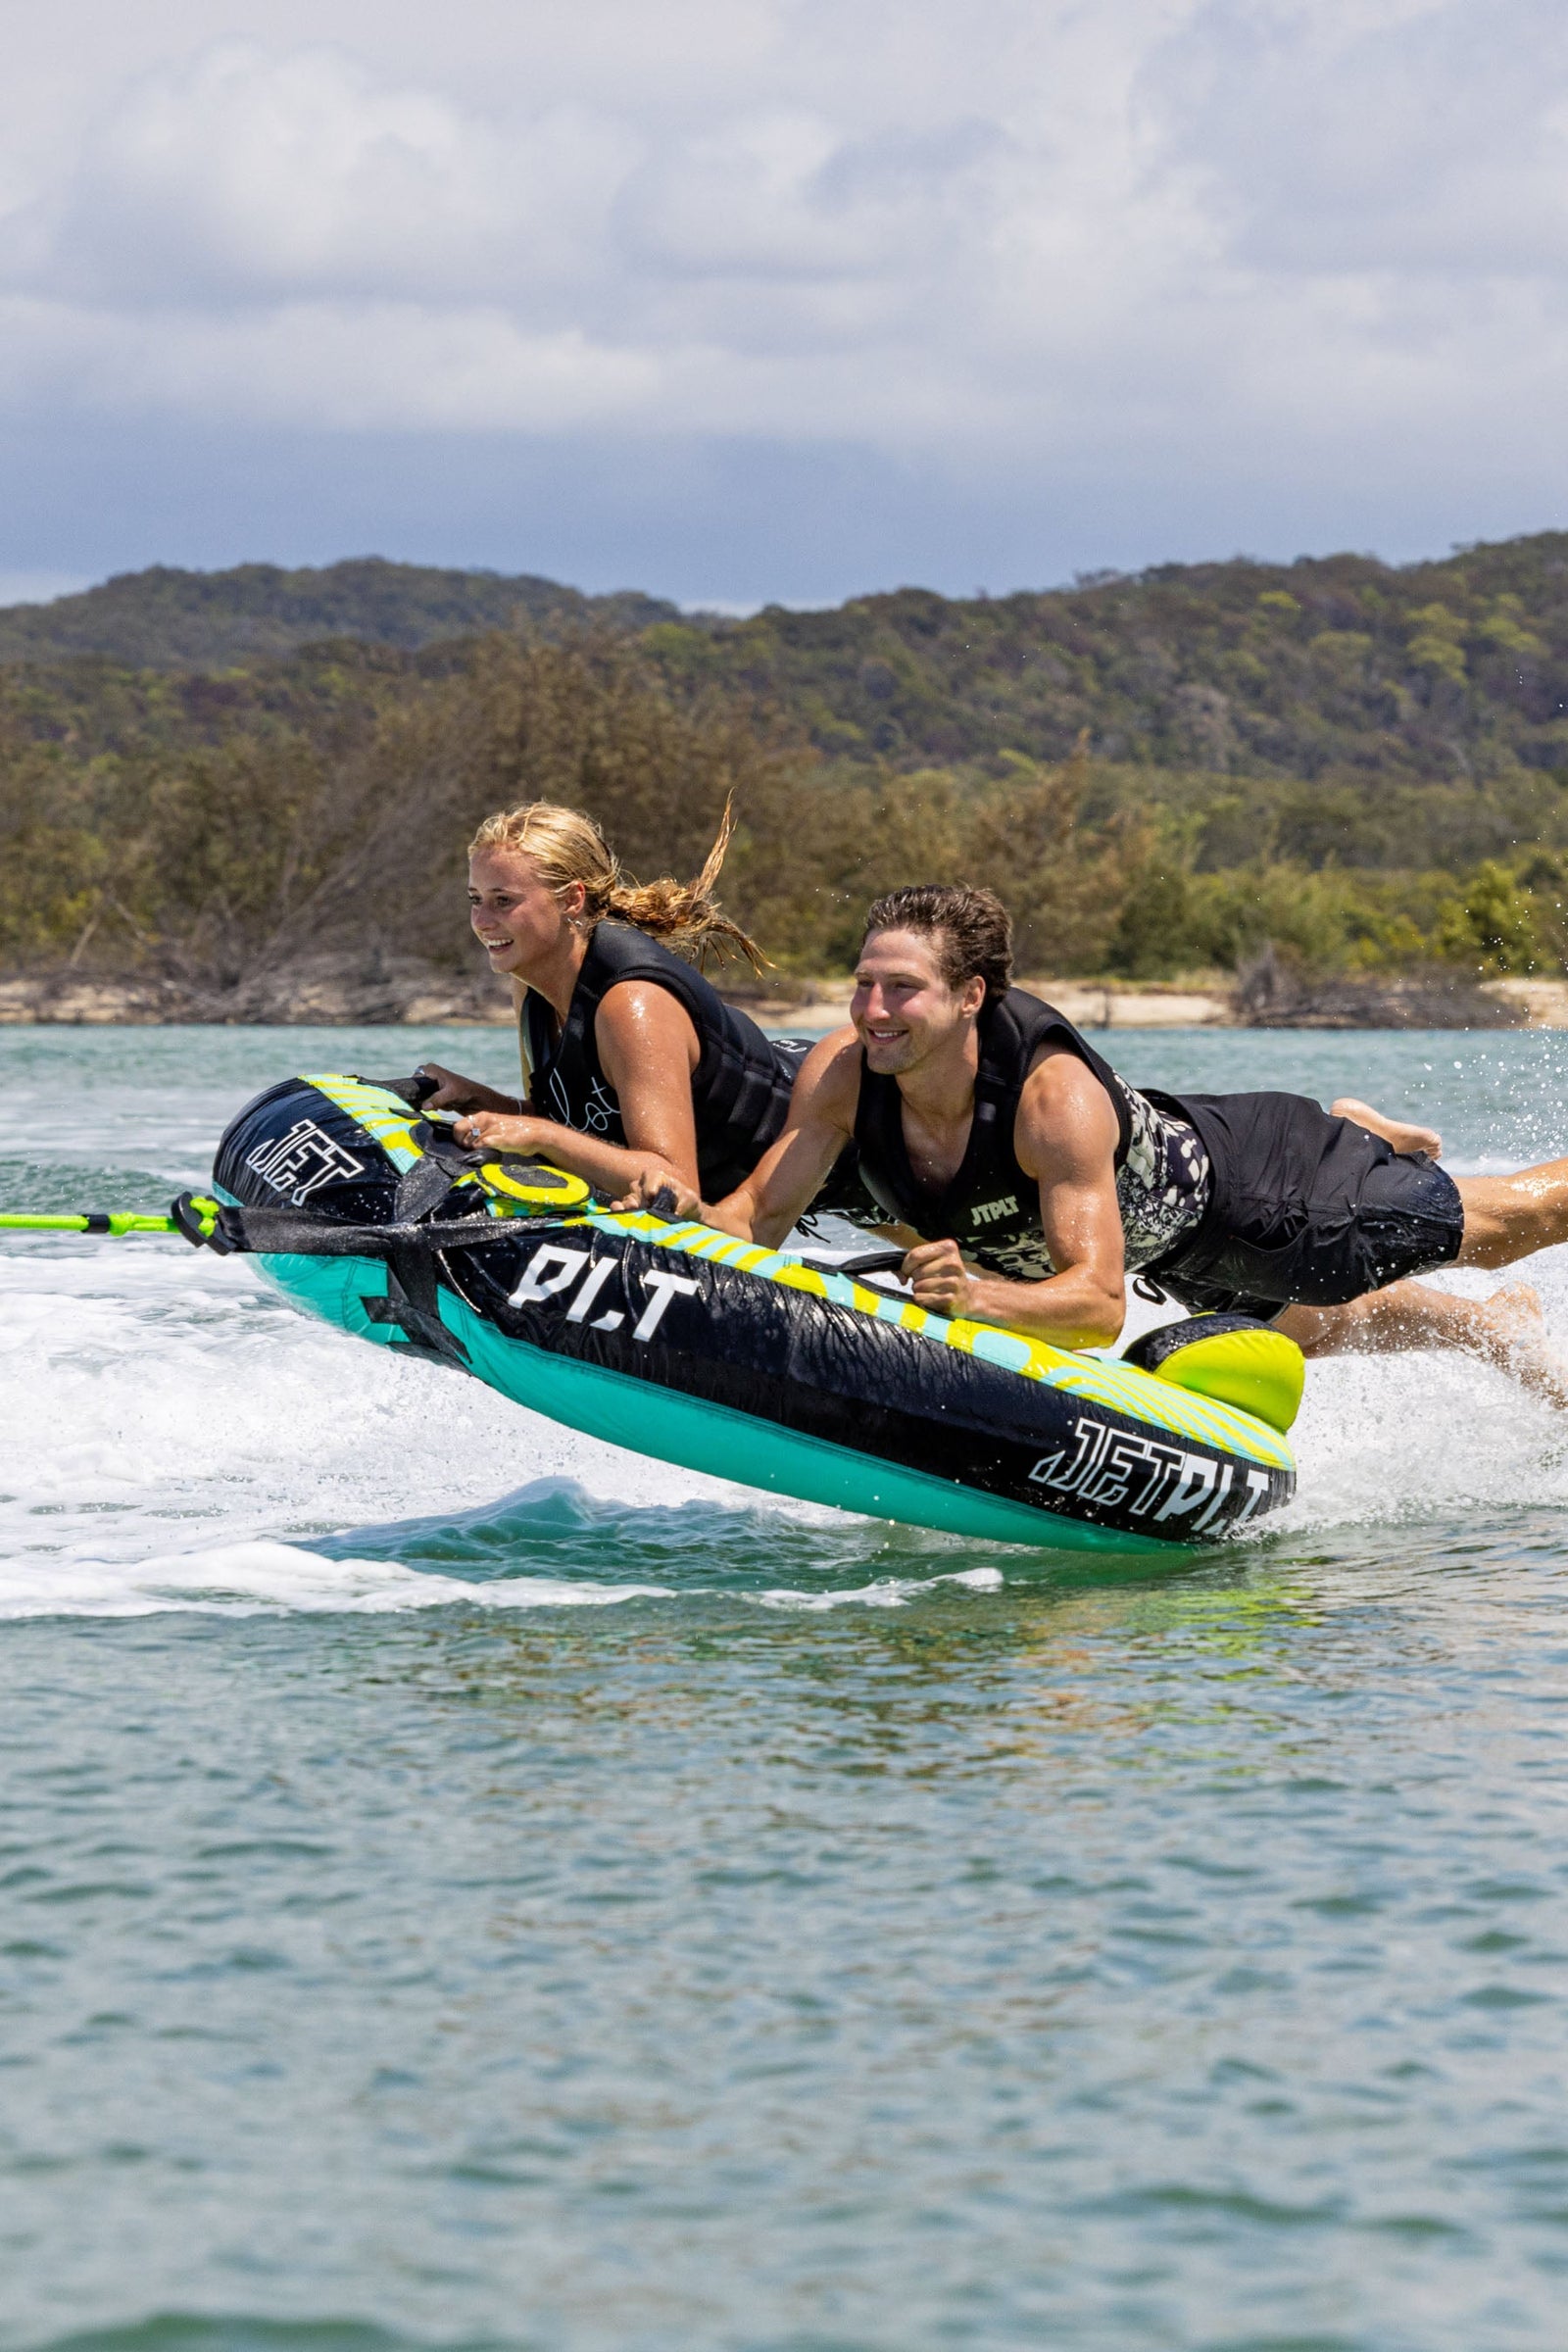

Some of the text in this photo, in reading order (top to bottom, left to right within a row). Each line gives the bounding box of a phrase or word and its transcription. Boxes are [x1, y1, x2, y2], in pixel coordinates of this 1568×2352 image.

[245, 1118, 366, 1206] JET
[970, 1195, 1019, 1226] JTPLT
[508, 1244, 701, 1343] PLT
